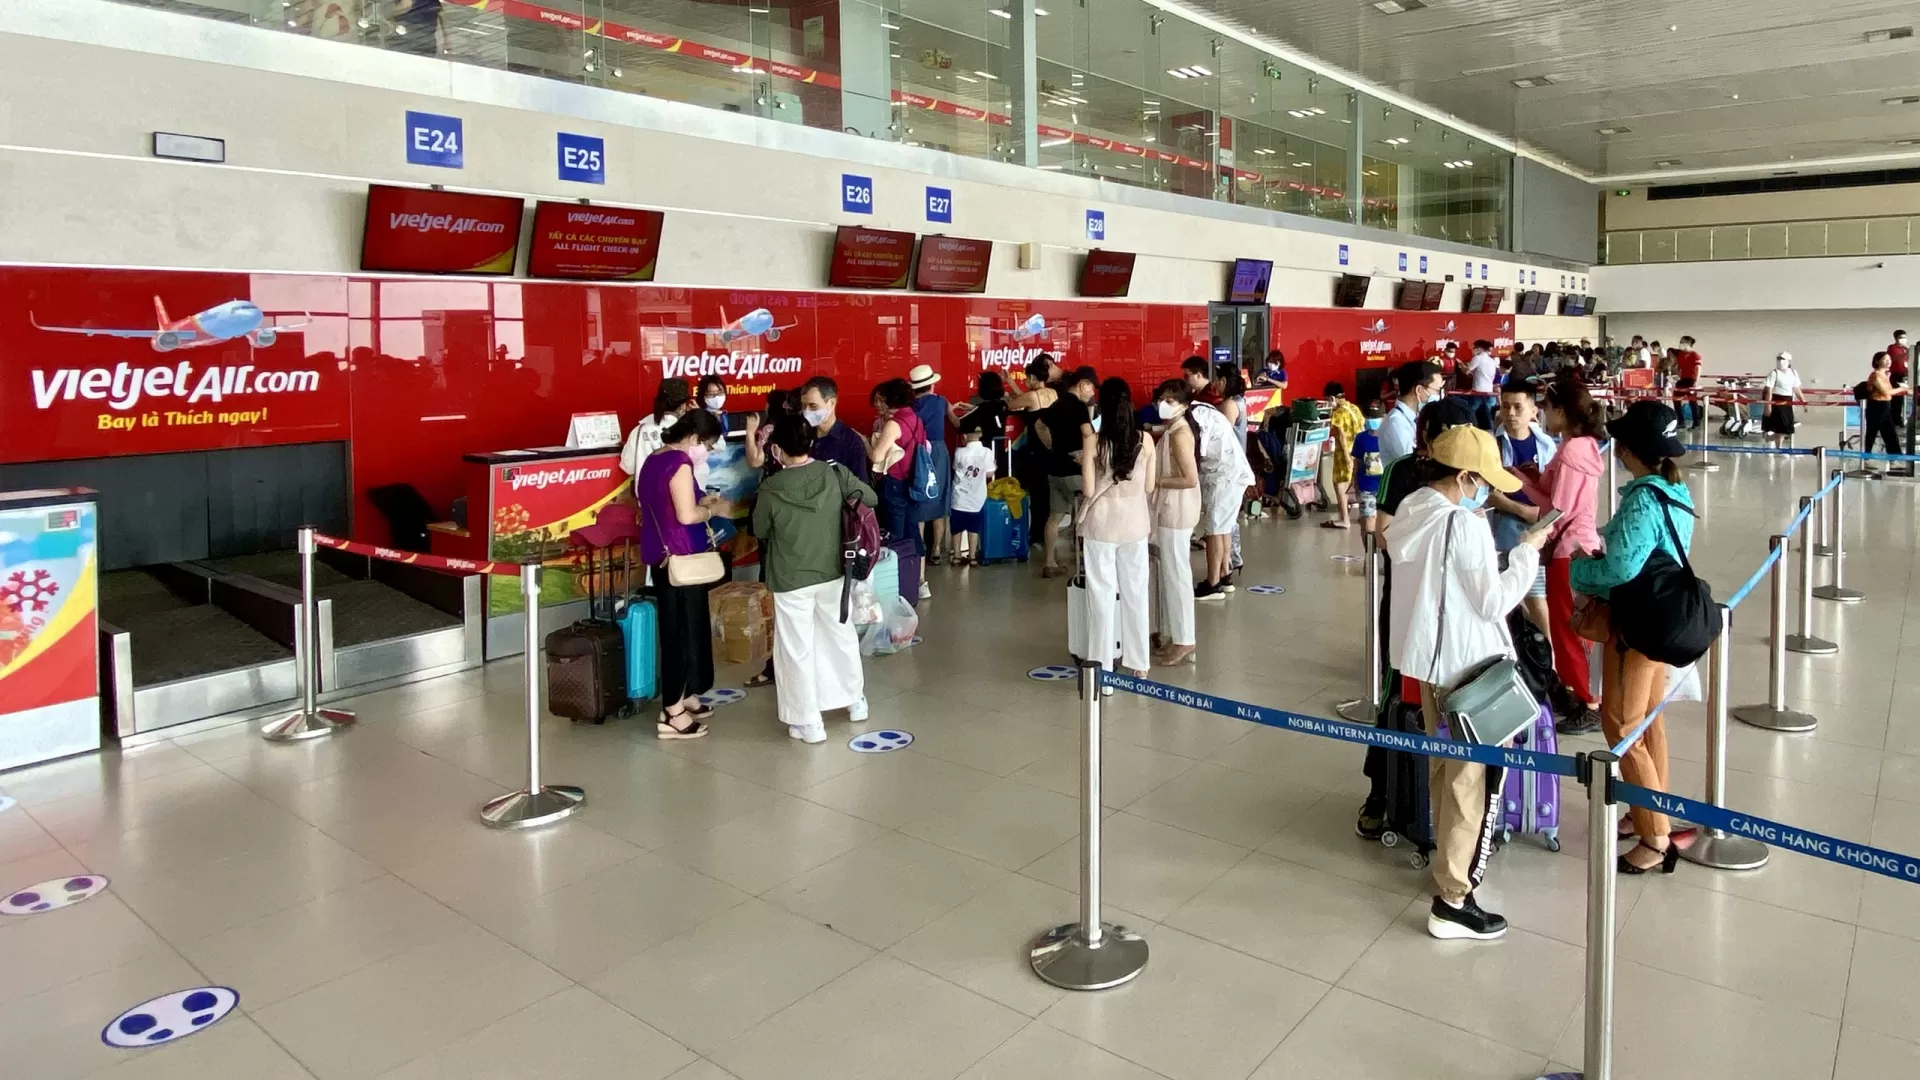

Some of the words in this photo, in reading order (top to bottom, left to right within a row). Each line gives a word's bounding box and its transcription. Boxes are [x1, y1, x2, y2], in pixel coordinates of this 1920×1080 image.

[414, 127, 458, 154] E24
[564, 147, 600, 171] E25
[846, 185, 870, 204] E26
[929, 197, 949, 213] E27
[1088, 218, 1103, 232] E28
[553, 242, 569, 250] ALL
[572, 243, 600, 252] FLIGHT
[726, 383, 749, 394] Thích
[97, 413, 136, 432] Bay
[142, 412, 159, 427] là
[164, 409, 213, 426] Thích
[218, 407, 267, 425] ngay!
[1103, 674, 1134, 690] KHÔNG
[1136, 682, 1163, 697] QUỐC
[1165, 688, 1176, 700] TẾ
[1178, 692, 1195, 706] NỘI
[1237, 706, 1261, 720] N.I.A
[1288, 717, 1324, 733] NOIBAI
[1327, 724, 1416, 749] INTERNATIONAL
[1421, 741, 1472, 757] AIRPORT
[1504, 753, 1535, 767] N.I.A
[1652, 795, 1686, 815] N.I.A
[1836, 846, 1899, 873] KHÔNG
